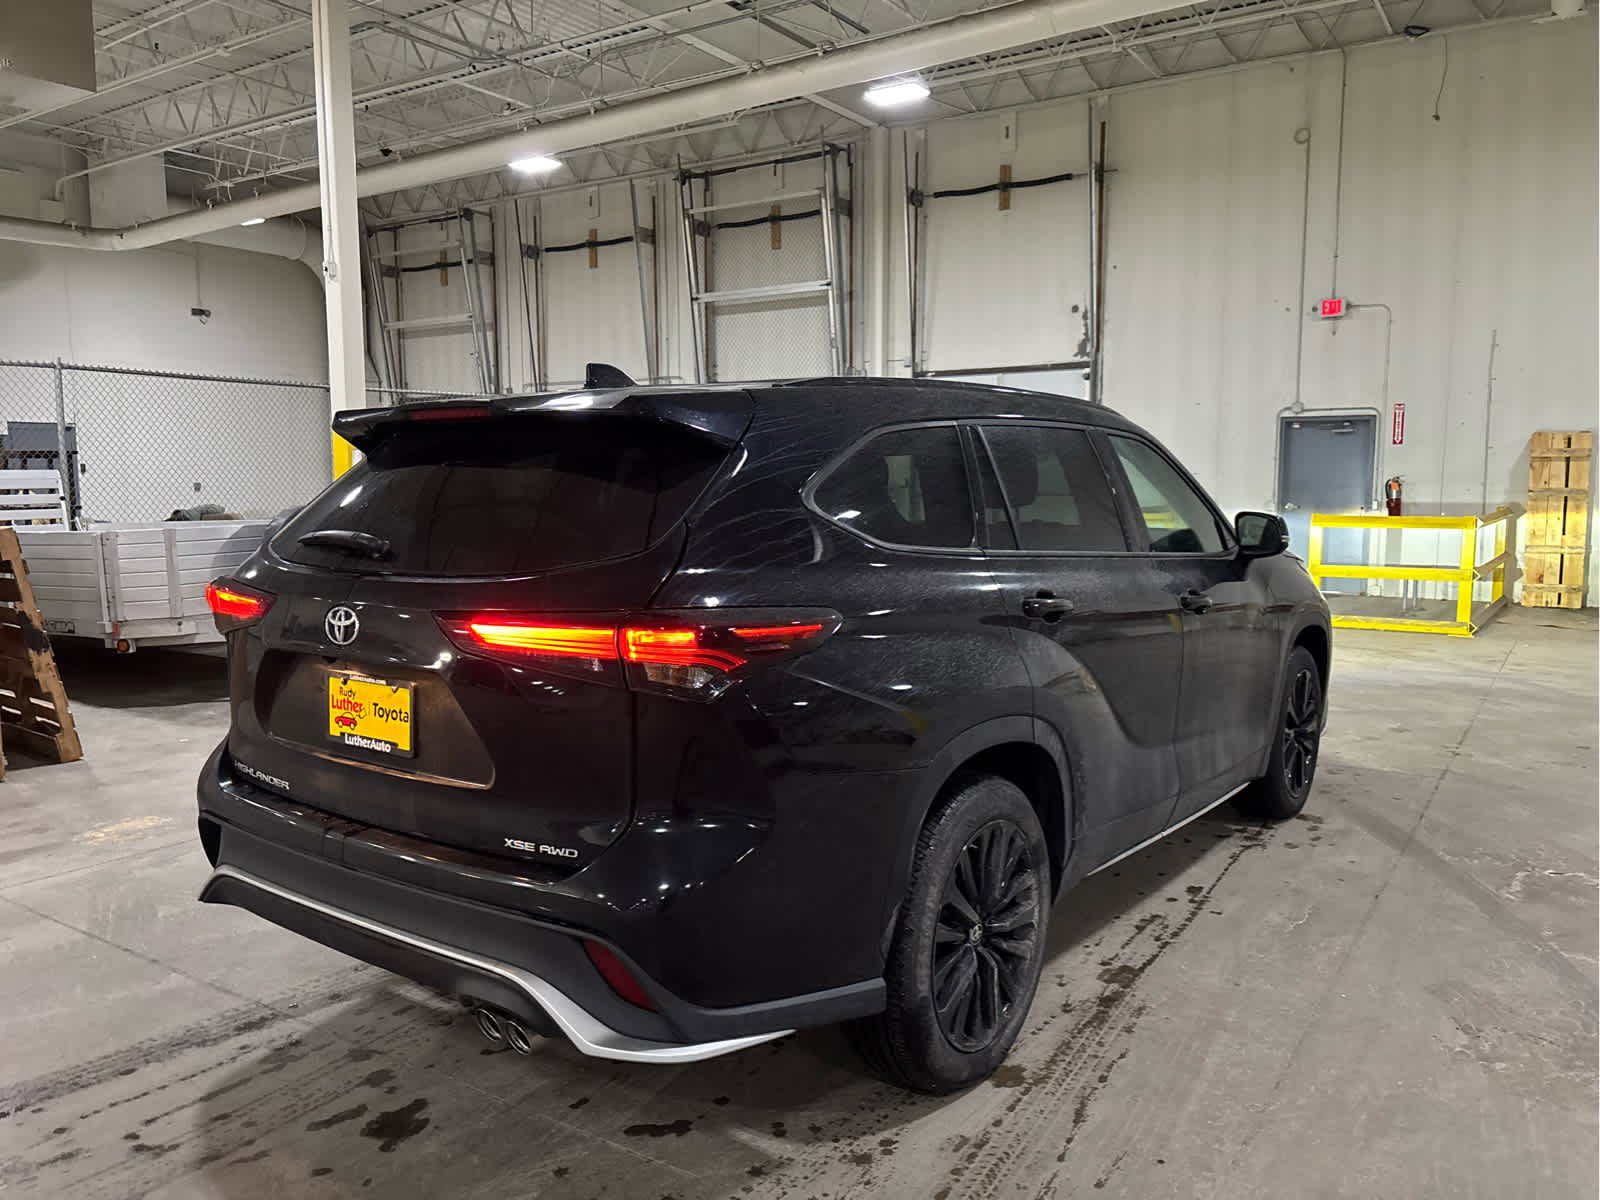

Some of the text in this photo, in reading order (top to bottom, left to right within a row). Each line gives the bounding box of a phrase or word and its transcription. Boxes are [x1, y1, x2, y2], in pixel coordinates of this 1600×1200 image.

[339, 686, 355, 699] Rudy
[331, 694, 363, 713] Luther
[372, 702, 409, 722] Toyota
[344, 733, 391, 753] LutherAuto
[234, 760, 290, 790] HIGHLANDER
[504, 838, 578, 858] XSE AWD
